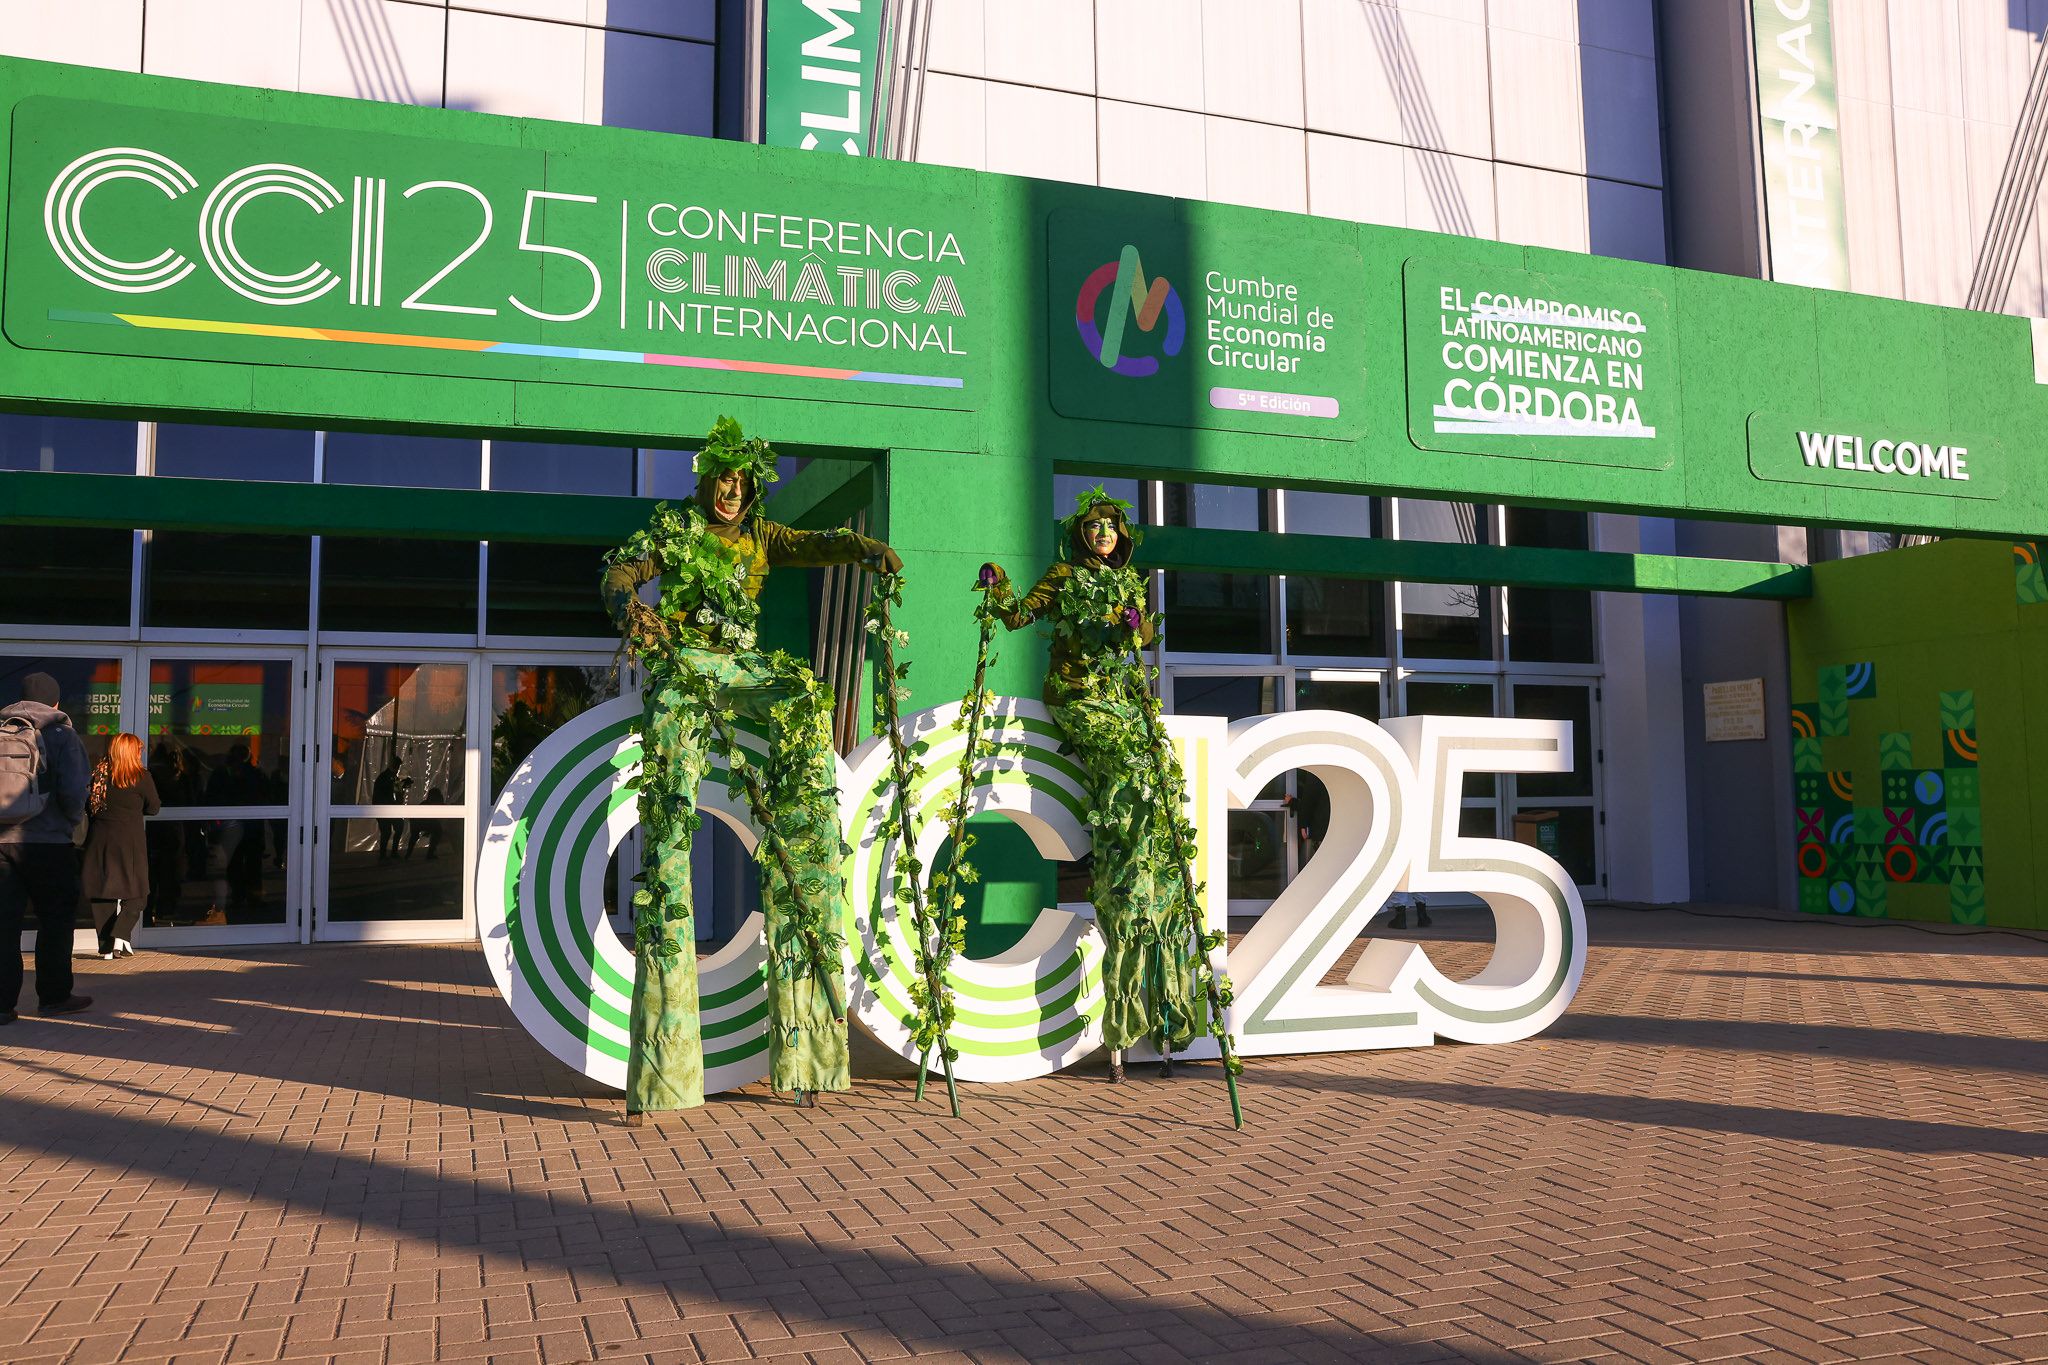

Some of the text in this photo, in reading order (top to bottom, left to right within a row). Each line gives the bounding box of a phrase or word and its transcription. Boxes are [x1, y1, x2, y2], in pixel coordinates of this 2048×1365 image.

[44, 147, 602, 322] CCI25
[646, 203, 966, 265] CONFERENCIA
[1205, 270, 1298, 301] Cumbre
[647, 300, 967, 355] INTERNACIONAL
[1207, 294, 1334, 330] Mundial de
[1440, 286, 1643, 334] EL COMPROMISO
[1207, 320, 1326, 353] Economía
[1207, 345, 1301, 374] Circular
[1440, 314, 1643, 359] LATINOAMERICANO
[1441, 341, 1643, 391] COMIENZA EN
[1260, 394, 1311, 412] Edición
[1443, 375, 1645, 434] CÓRDOBA
[1797, 430, 1970, 481] WELCOME
